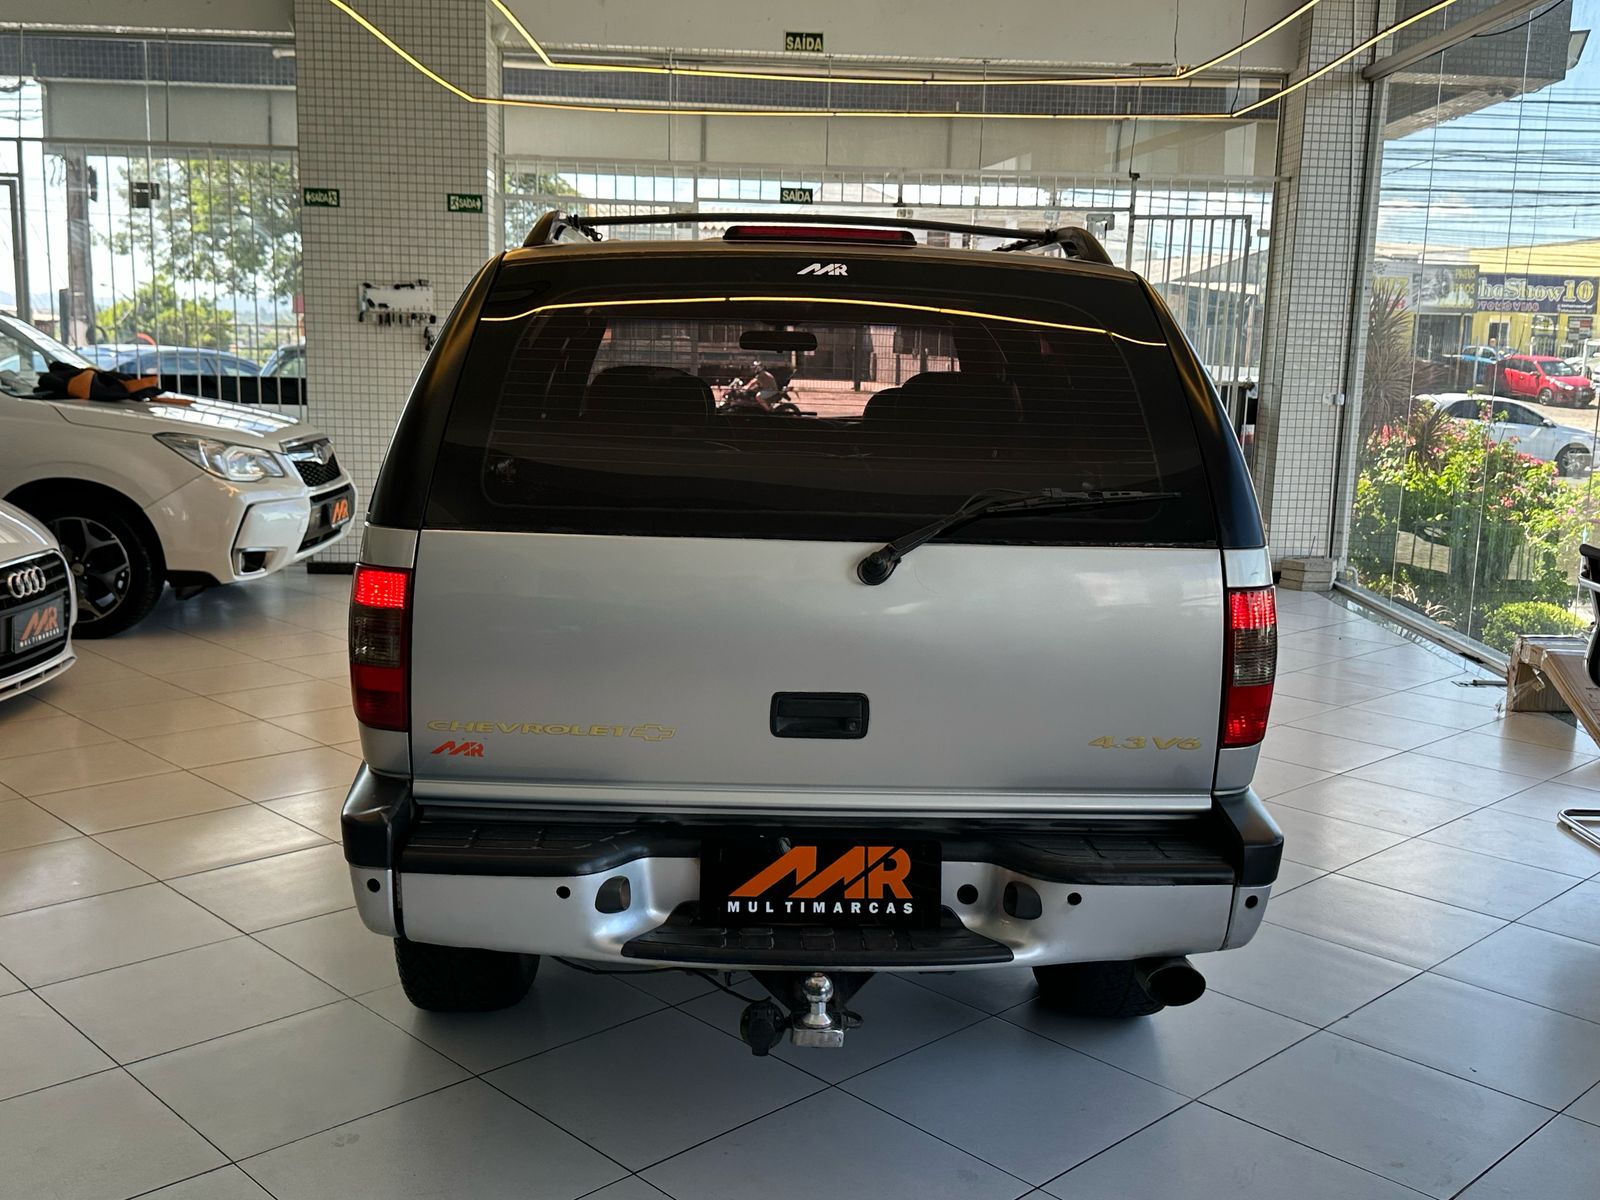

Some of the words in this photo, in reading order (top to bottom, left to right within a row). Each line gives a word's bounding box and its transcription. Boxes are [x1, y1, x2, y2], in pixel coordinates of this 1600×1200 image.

[786, 33, 823, 50] SAÍDA
[782, 189, 812, 202] SAÍDA
[426, 719, 626, 737] CHEVROLET
[727, 901, 914, 914] MULTIMARCAS
